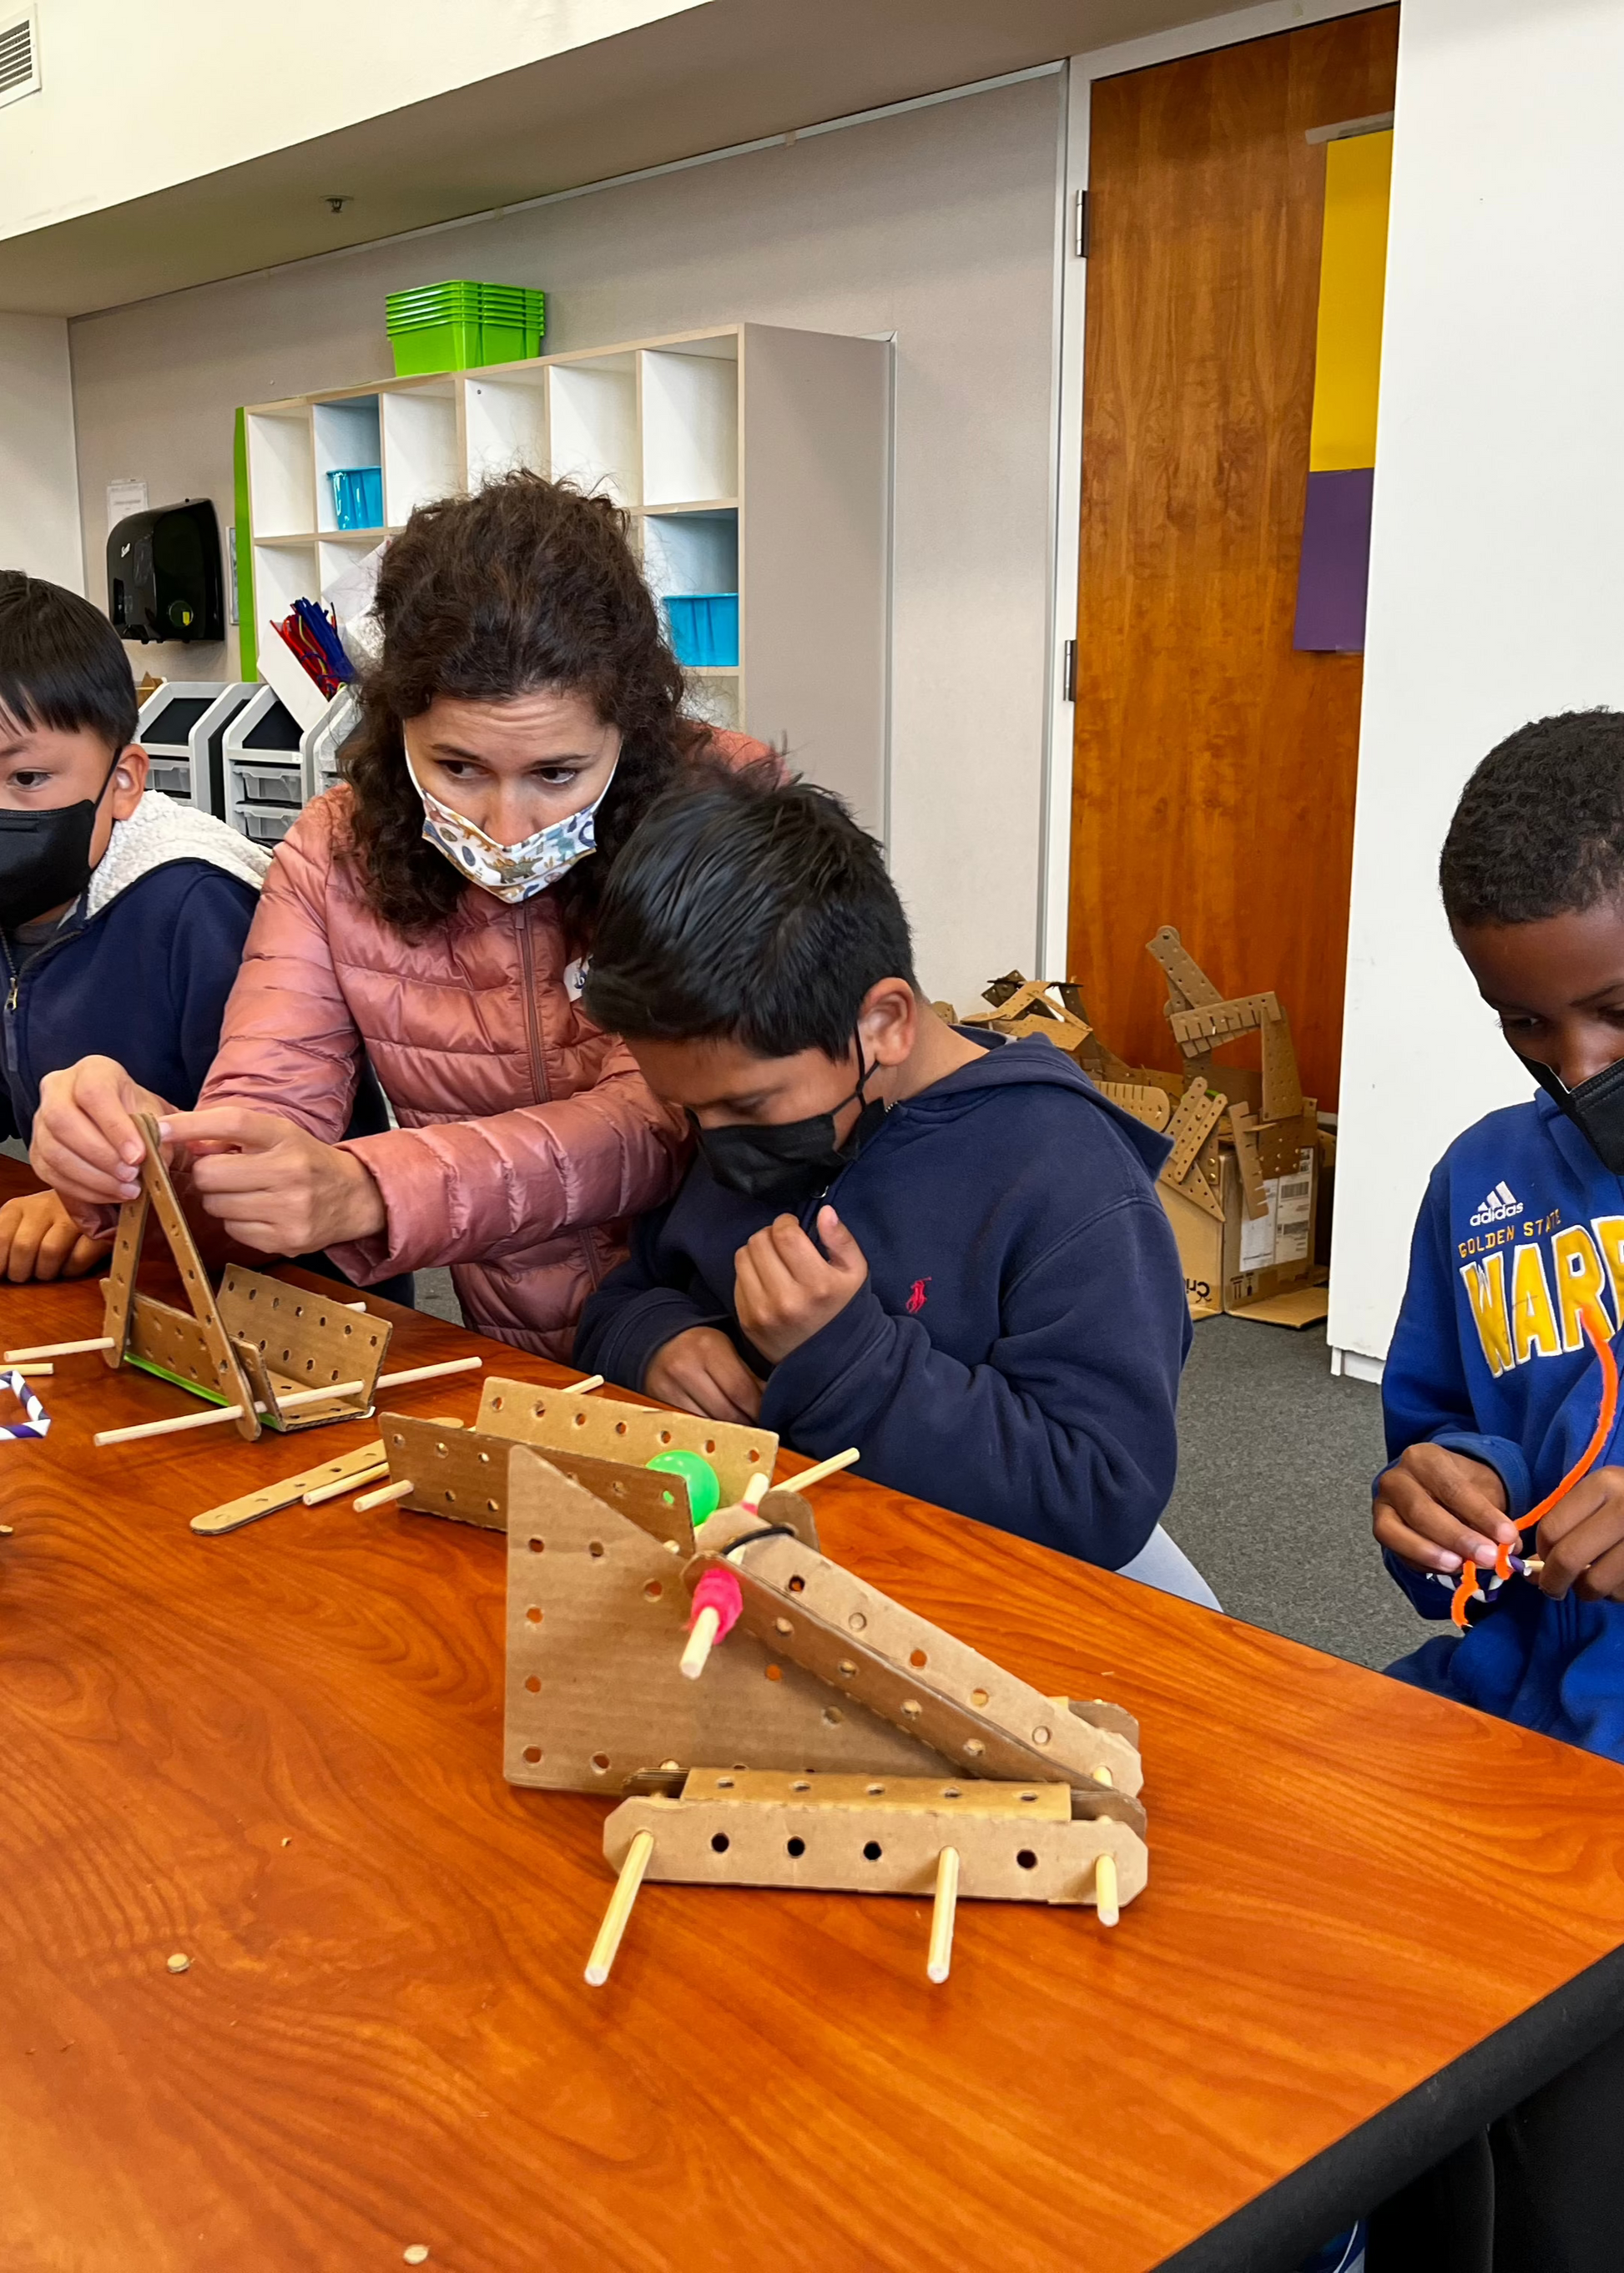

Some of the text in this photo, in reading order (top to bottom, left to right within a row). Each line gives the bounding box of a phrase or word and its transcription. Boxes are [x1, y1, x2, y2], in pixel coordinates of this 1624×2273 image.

[1470, 1202, 1524, 1227] adidas
[1458, 1208, 1561, 1258] GOLDEN STATE
[1183, 1278, 1210, 1298] Cri
